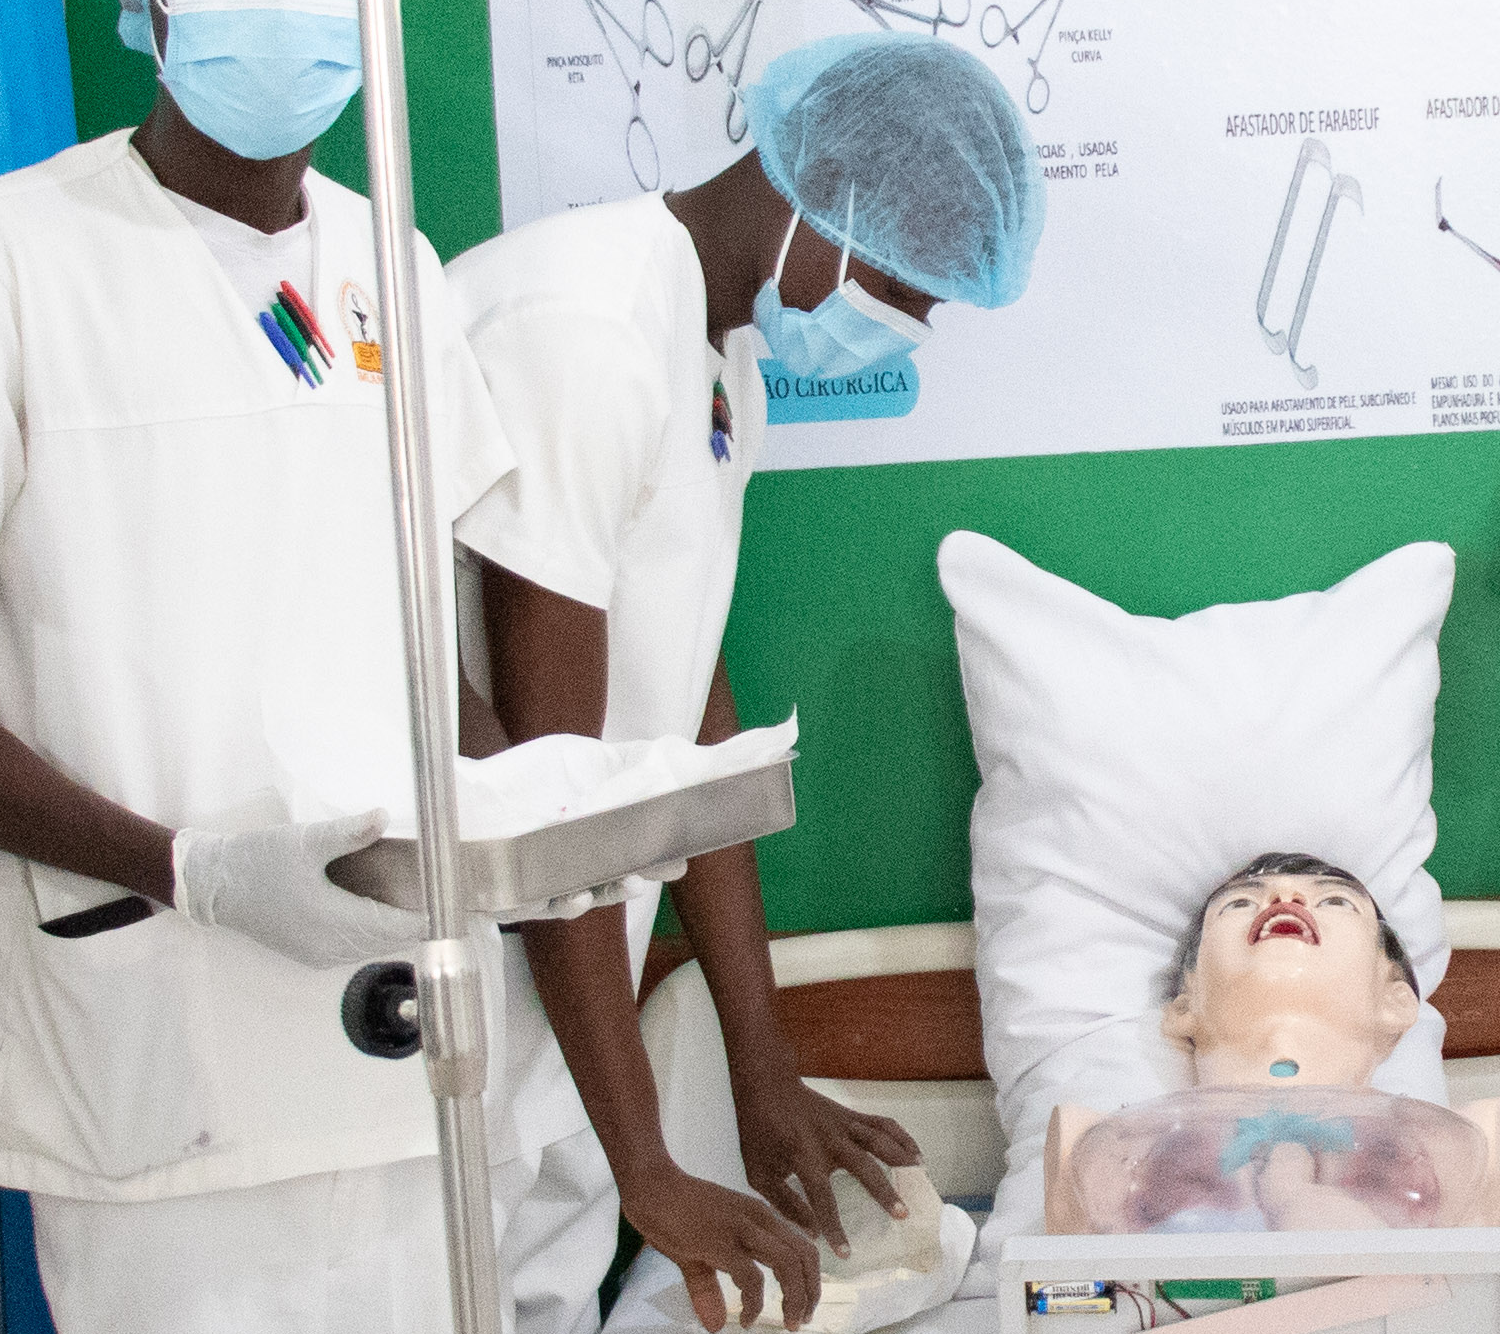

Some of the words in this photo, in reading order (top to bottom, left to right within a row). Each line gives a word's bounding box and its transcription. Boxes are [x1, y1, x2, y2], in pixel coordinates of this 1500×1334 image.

[1058, 30, 1086, 45] PINÇA
[1088, 28, 1113, 42] KELLY
[1071, 50, 1102, 64] CURVA
[1425, 95, 1490, 120] AFASTADOR
[1225, 112, 1296, 138] AFASTADOR
[1298, 110, 1316, 134] DE
[1318, 106, 1380, 133] FARABEUF
[1079, 140, 1118, 157] USADAS
[1095, 162, 1119, 178] PELA
[1431, 375, 1458, 390] MESMO
[1463, 374, 1477, 388] USO
[1483, 373, 1494, 387] DO
[1221, 400, 1249, 416] USADO
[1250, 399, 1270, 413] PARA
[1271, 396, 1326, 413] AFASTAMENTO
[1327, 395, 1337, 409] DE
[1360, 389, 1411, 407] SUBCUTÂNEO
[1222, 417, 1265, 436] MÚSCULOS
[1266, 420, 1278, 434] EM
[1279, 418, 1305, 433] PLANO
